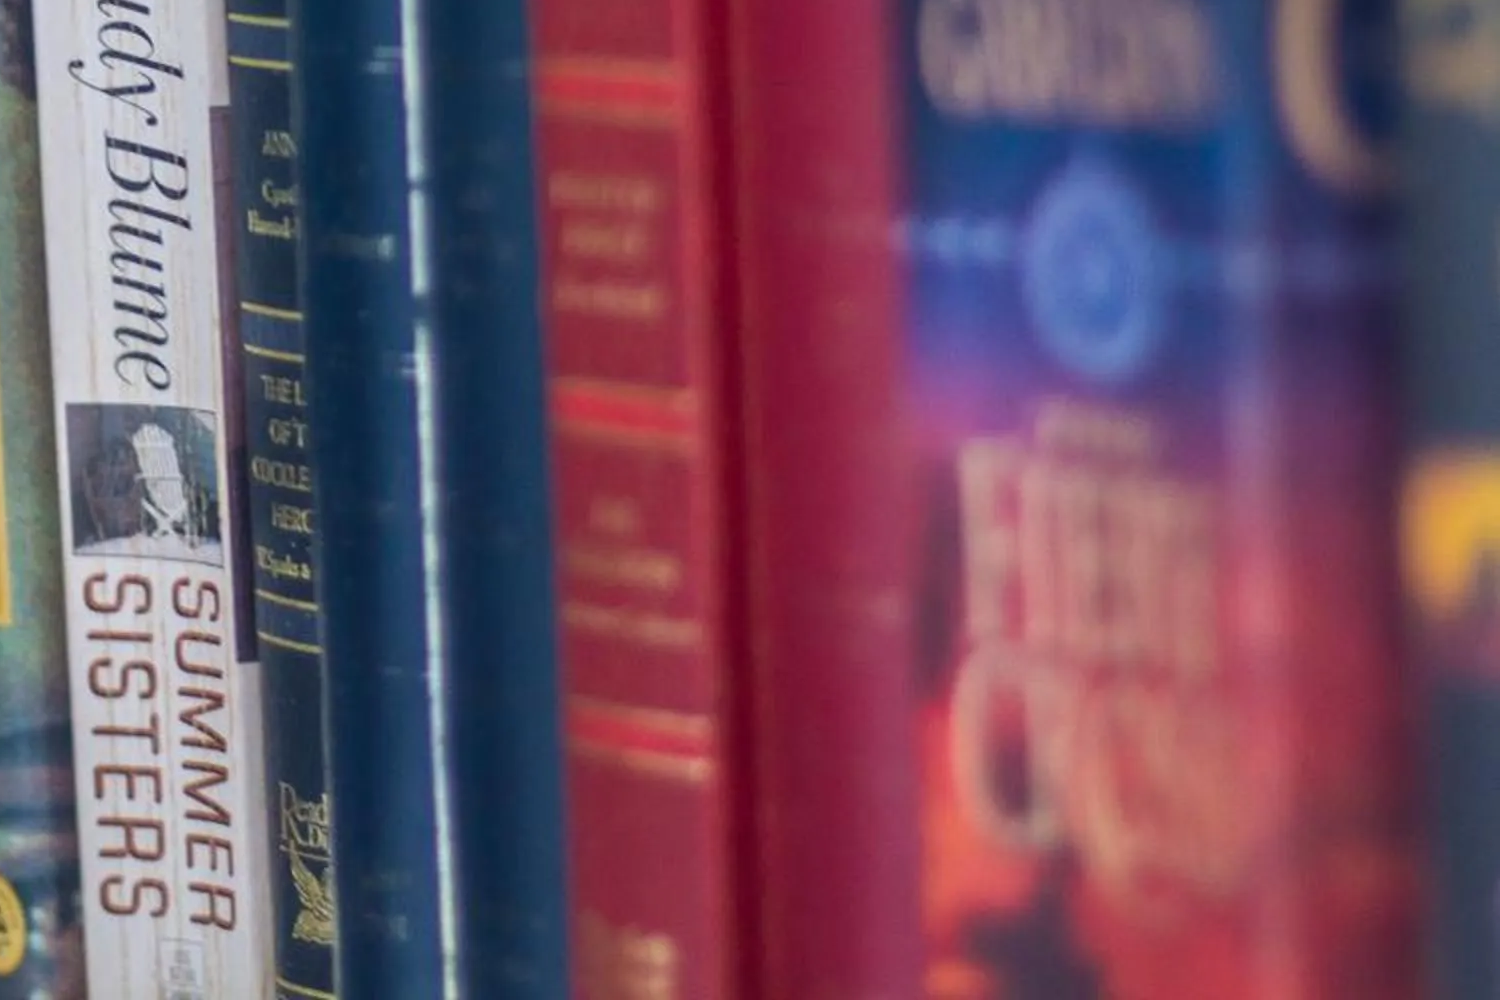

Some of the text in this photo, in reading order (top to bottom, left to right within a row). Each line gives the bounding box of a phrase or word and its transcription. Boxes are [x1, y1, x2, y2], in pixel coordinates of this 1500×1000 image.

[103, 131, 192, 391] Blume
[83, 572, 171, 919] SISTERS
[171, 576, 238, 932] SUMMER
